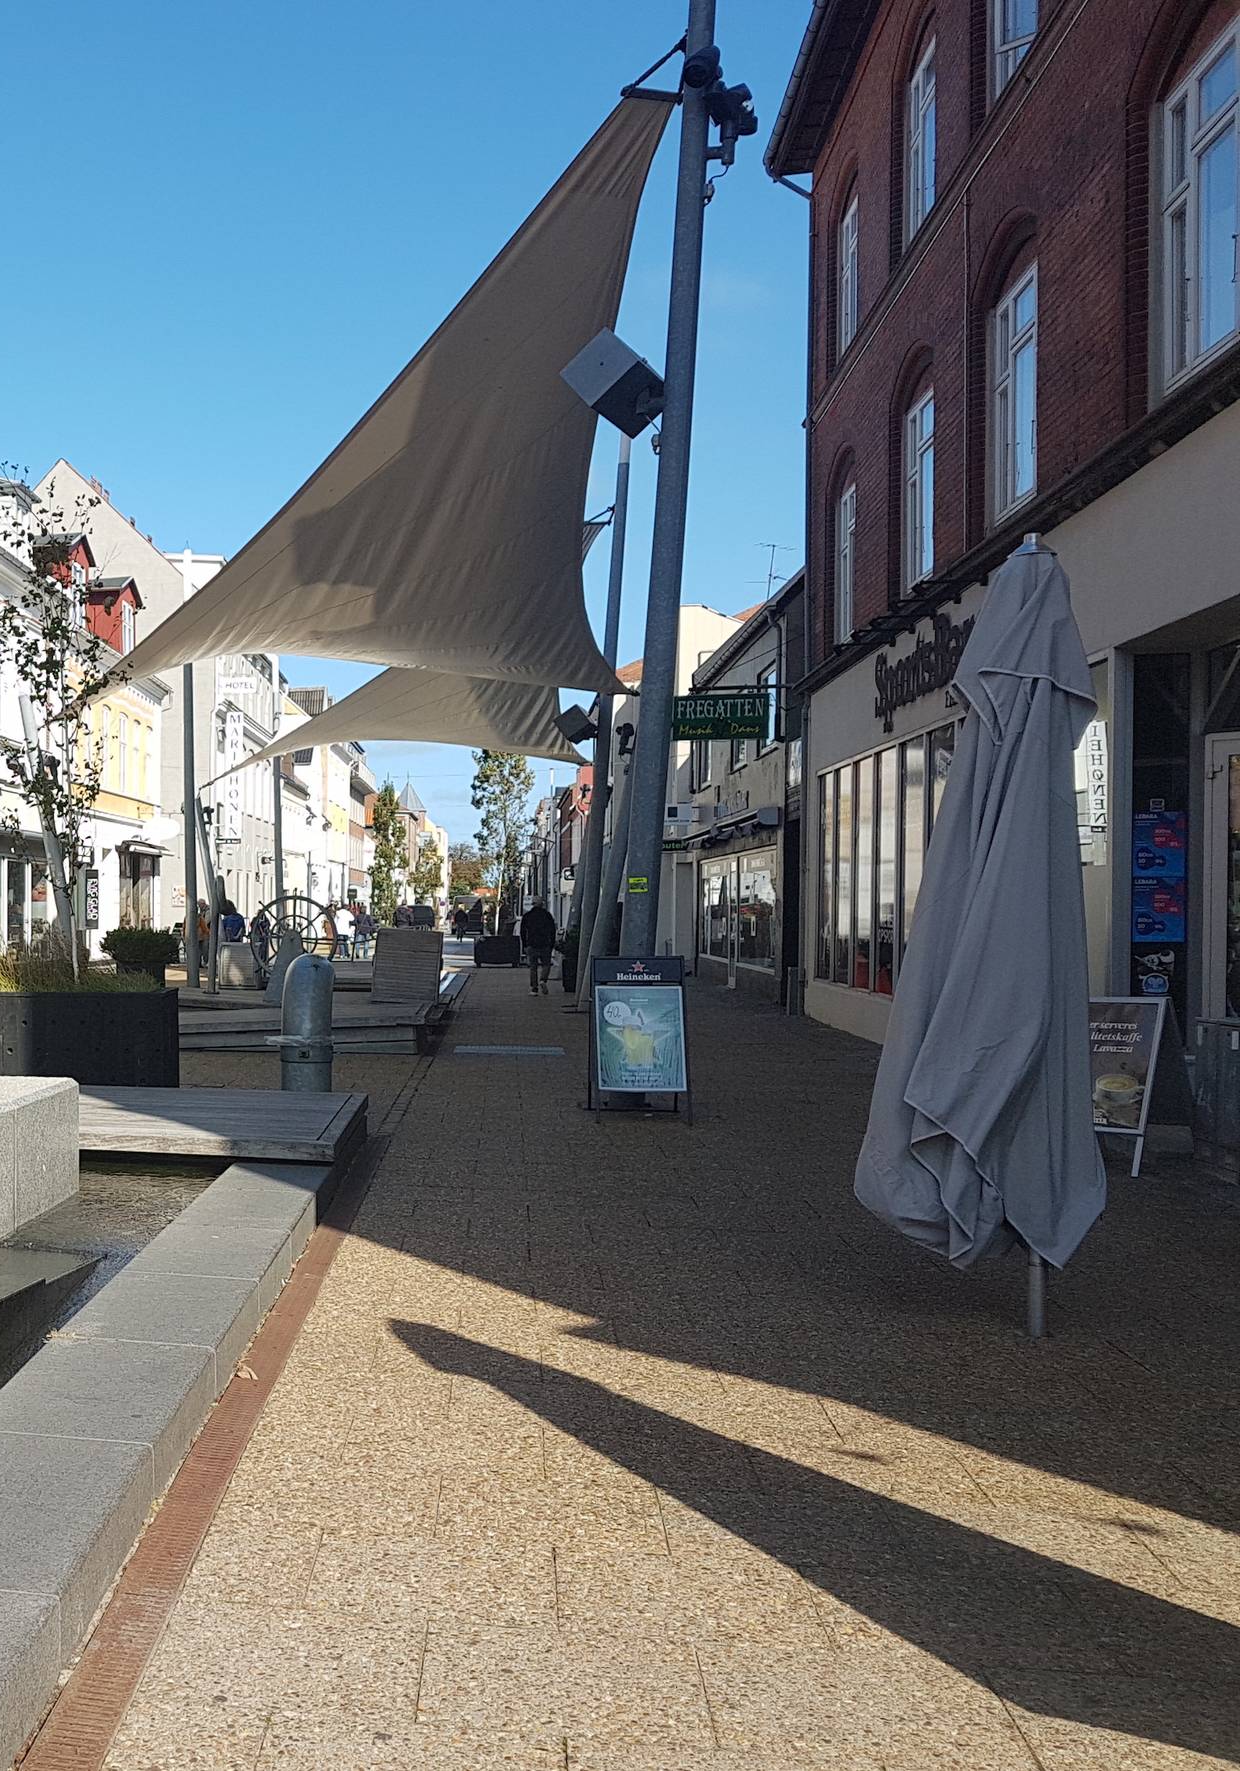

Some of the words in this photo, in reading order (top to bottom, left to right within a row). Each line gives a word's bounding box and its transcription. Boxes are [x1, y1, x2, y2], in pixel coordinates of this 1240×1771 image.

[225, 682, 255, 690] HOTEL
[676, 698, 765, 719] FREGATTEN
[616, 972, 662, 981] Heineken
[1090, 1031, 1142, 1042] litetskaffe
[1093, 1043, 1134, 1053] Lavazza
